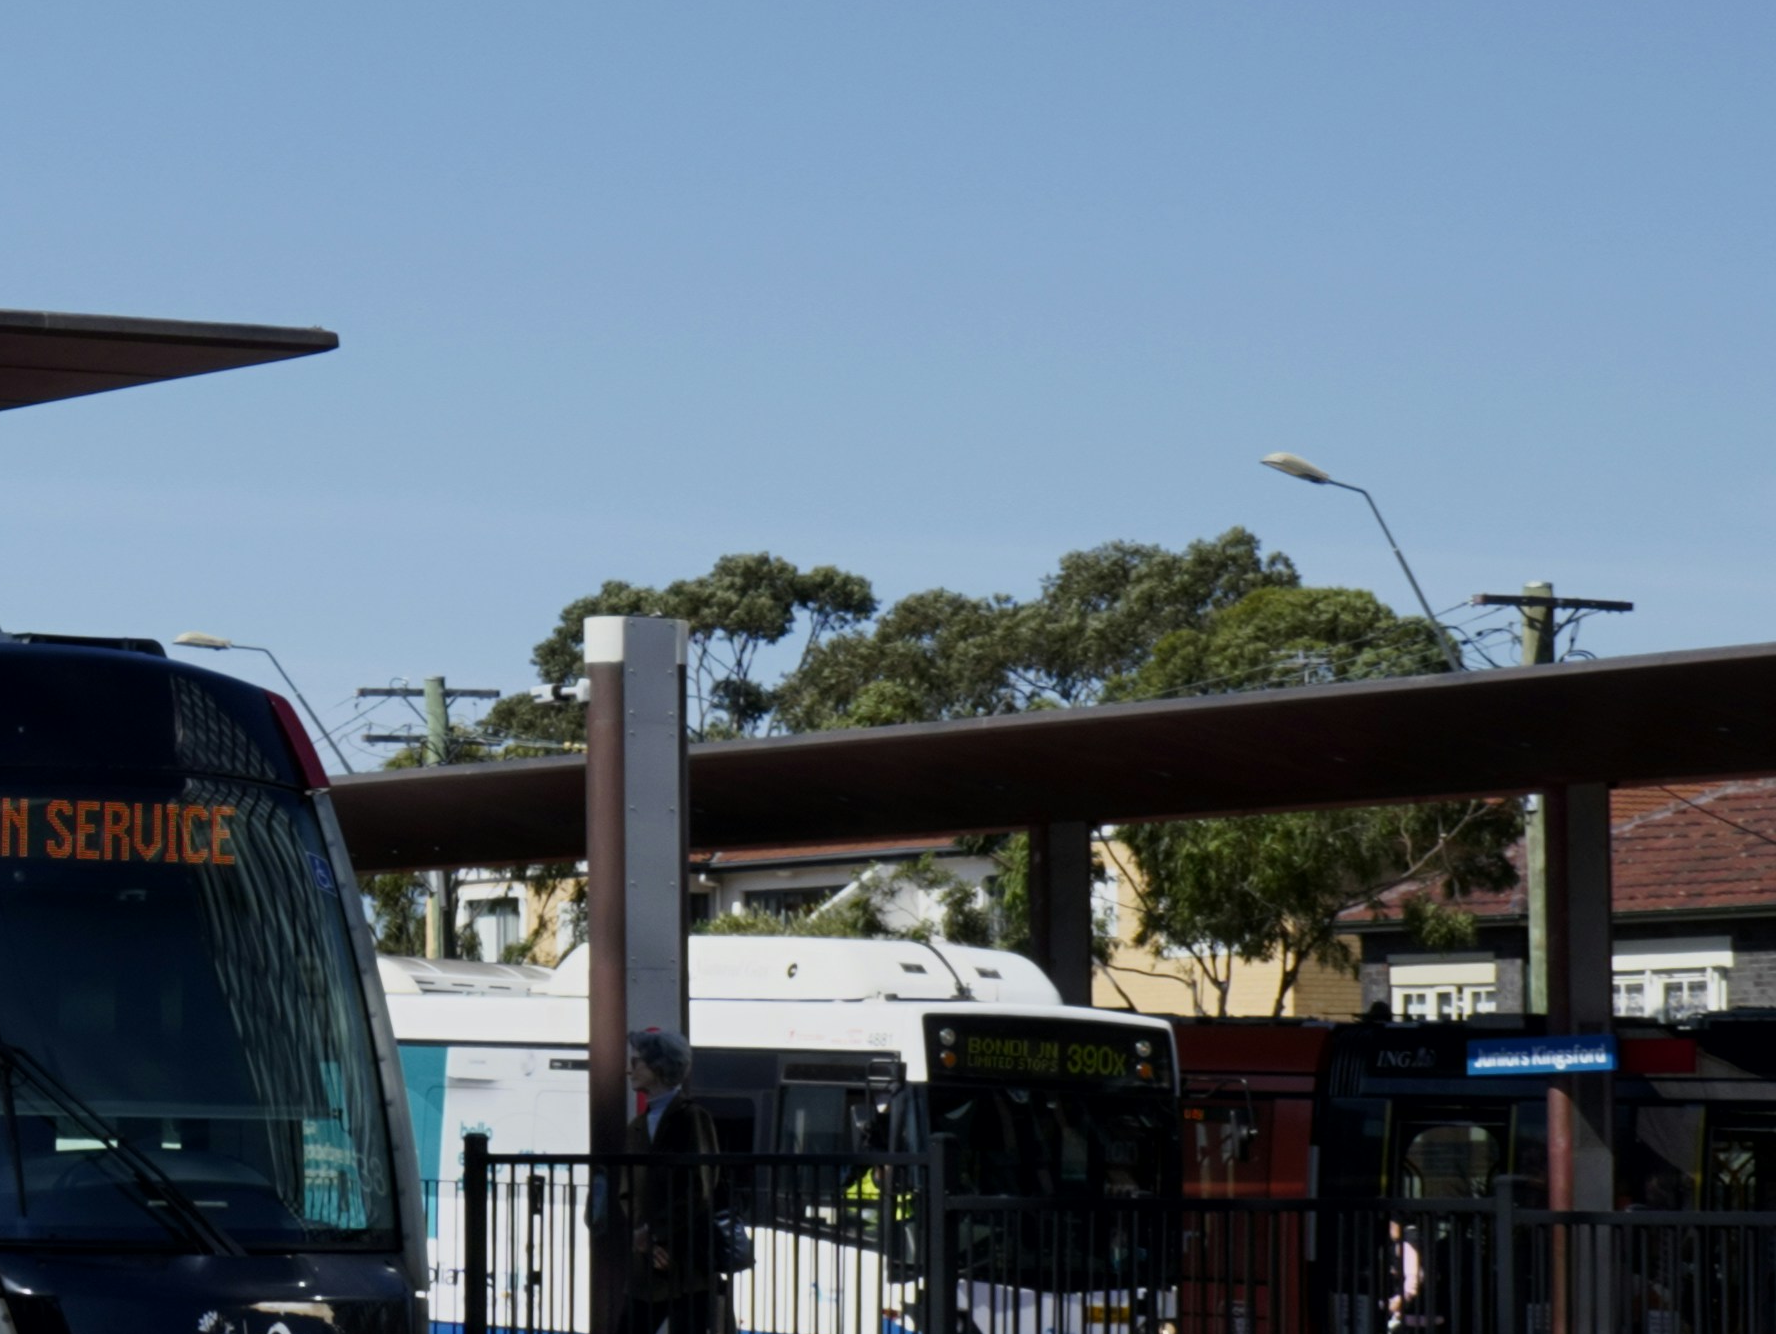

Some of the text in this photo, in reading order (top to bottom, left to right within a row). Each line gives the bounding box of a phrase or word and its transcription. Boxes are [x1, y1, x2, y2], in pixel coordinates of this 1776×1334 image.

[46, 799, 237, 865] SERVICE
[968, 1037, 1027, 1057] BONDI
[1038, 1041, 1058, 1058] JN
[1474, 1044, 1607, 1070] Juniors Kingsford
[968, 1057, 1058, 1072] LIMITED STOPS
[1376, 1050, 1415, 1068] ING
